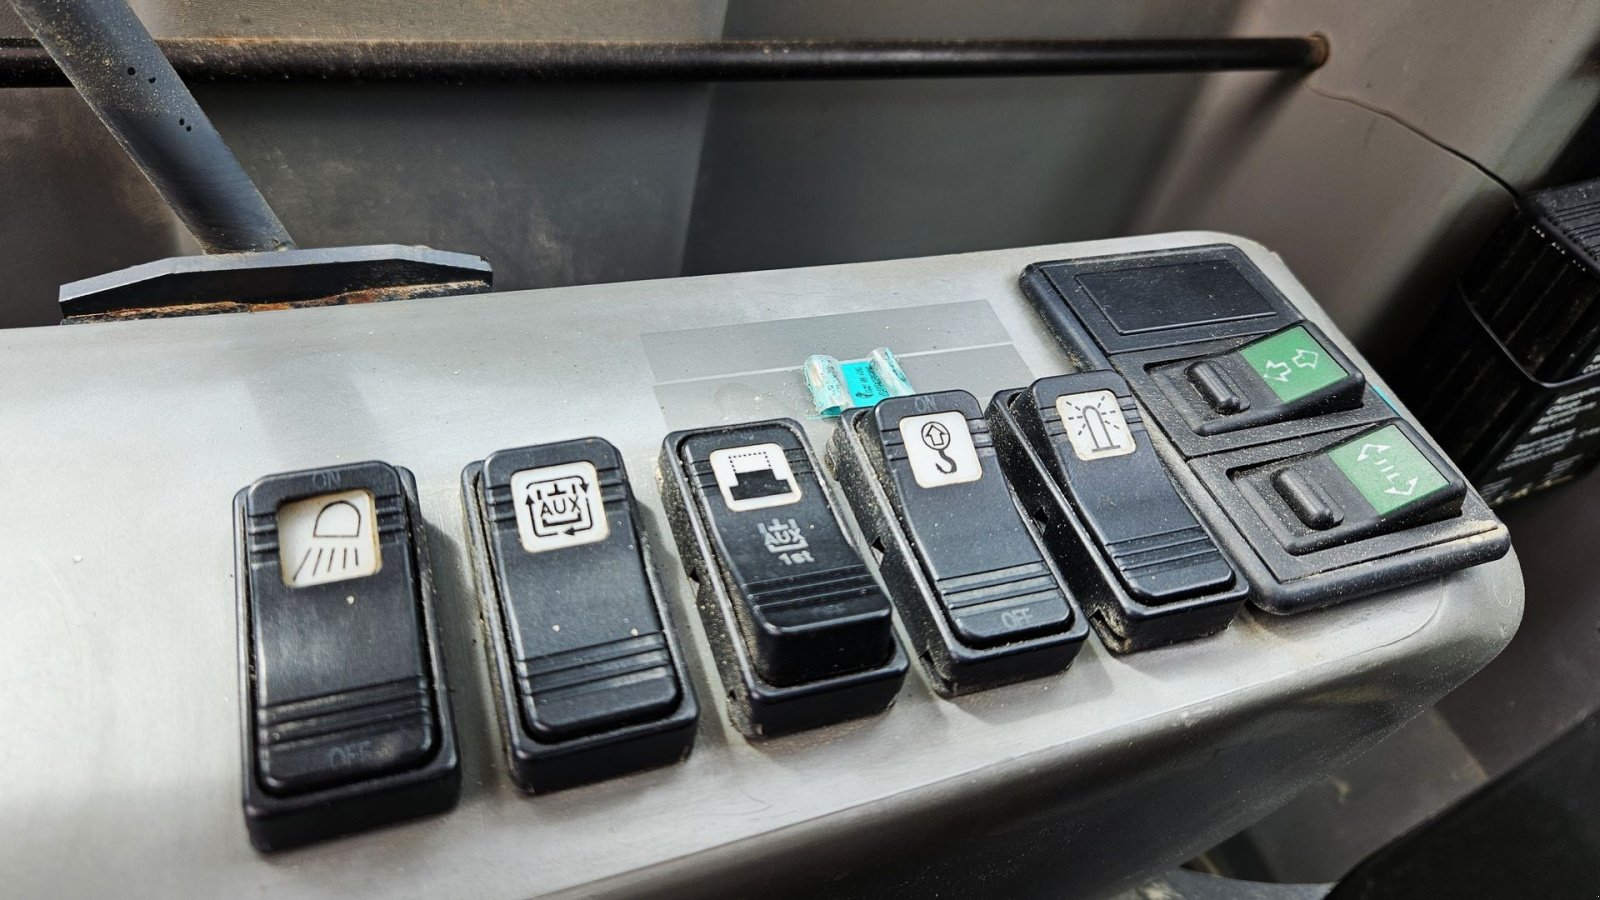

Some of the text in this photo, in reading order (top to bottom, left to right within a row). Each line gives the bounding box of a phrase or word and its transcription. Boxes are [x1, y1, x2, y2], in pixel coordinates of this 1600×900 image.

[914, 396, 936, 412] ON
[311, 469, 341, 488] ON
[540, 495, 581, 516] AUX
[1000, 606, 1036, 629] OFF
[328, 741, 372, 766] OFF
